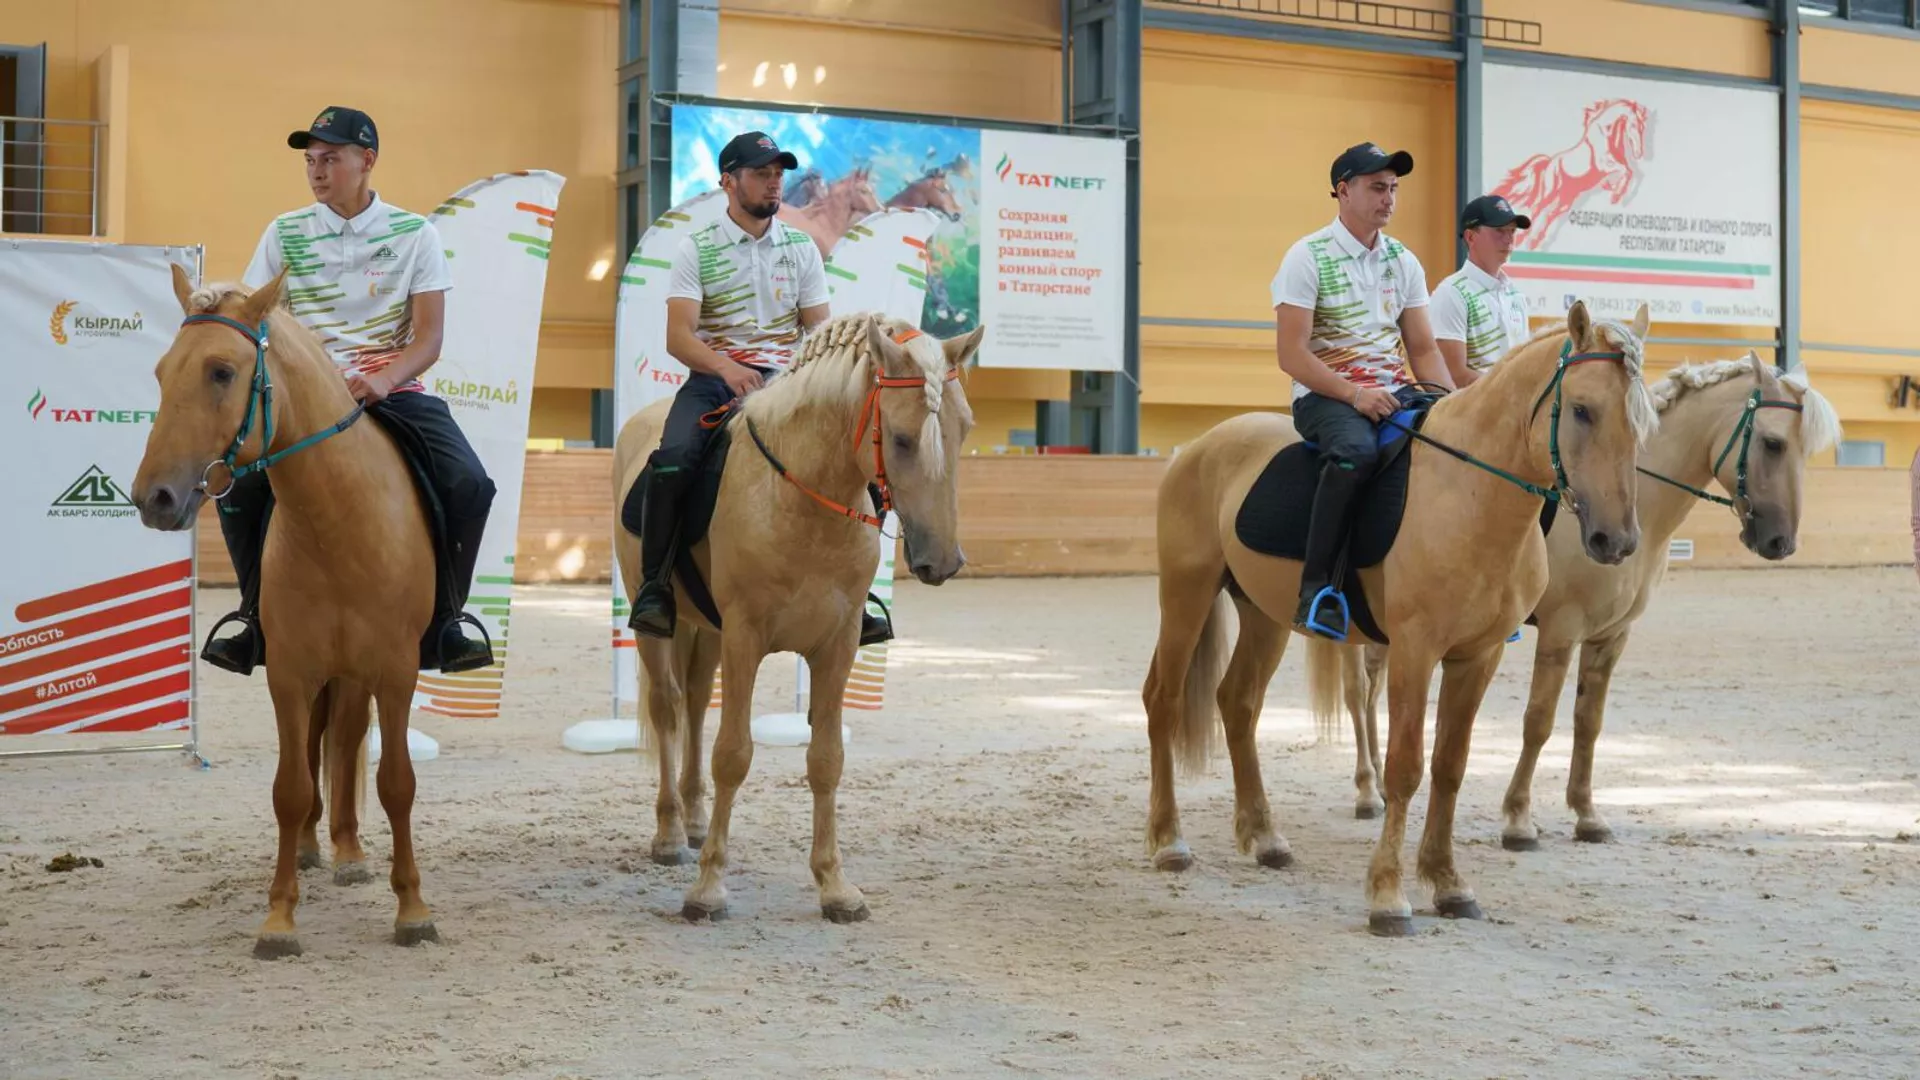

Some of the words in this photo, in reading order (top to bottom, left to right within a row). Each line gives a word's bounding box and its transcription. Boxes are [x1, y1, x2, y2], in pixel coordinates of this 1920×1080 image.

[1015, 172, 1106, 190] TATNEFT
[998, 208, 1069, 224] Сохраняя
[1569, 209, 1623, 230] ФЕДЕРАЦИЯ
[1625, 213, 1688, 232] КОНЕВОДСТВА
[1699, 218, 1738, 236] КОННОГО
[1740, 220, 1773, 237] СПОРТА
[998, 227, 1079, 244] традиции,
[998, 245, 1076, 259] развиваем
[1619, 234, 1678, 252] РЕСПУБЛИКИ
[1679, 237, 1726, 255] ТАТАРСТАН
[998, 263, 1058, 277] конный
[1060, 266, 1103, 280] спорт
[998, 281, 1007, 292] в
[1010, 280, 1092, 296] Татарстане
[74, 310, 143, 331] КЫРЛАЙ
[434, 376, 518, 404] КЫРЛАЙ
[46, 508, 60, 518] АК
[62, 508, 89, 518] БАРС
[35, 671, 97, 700] #Алтай
